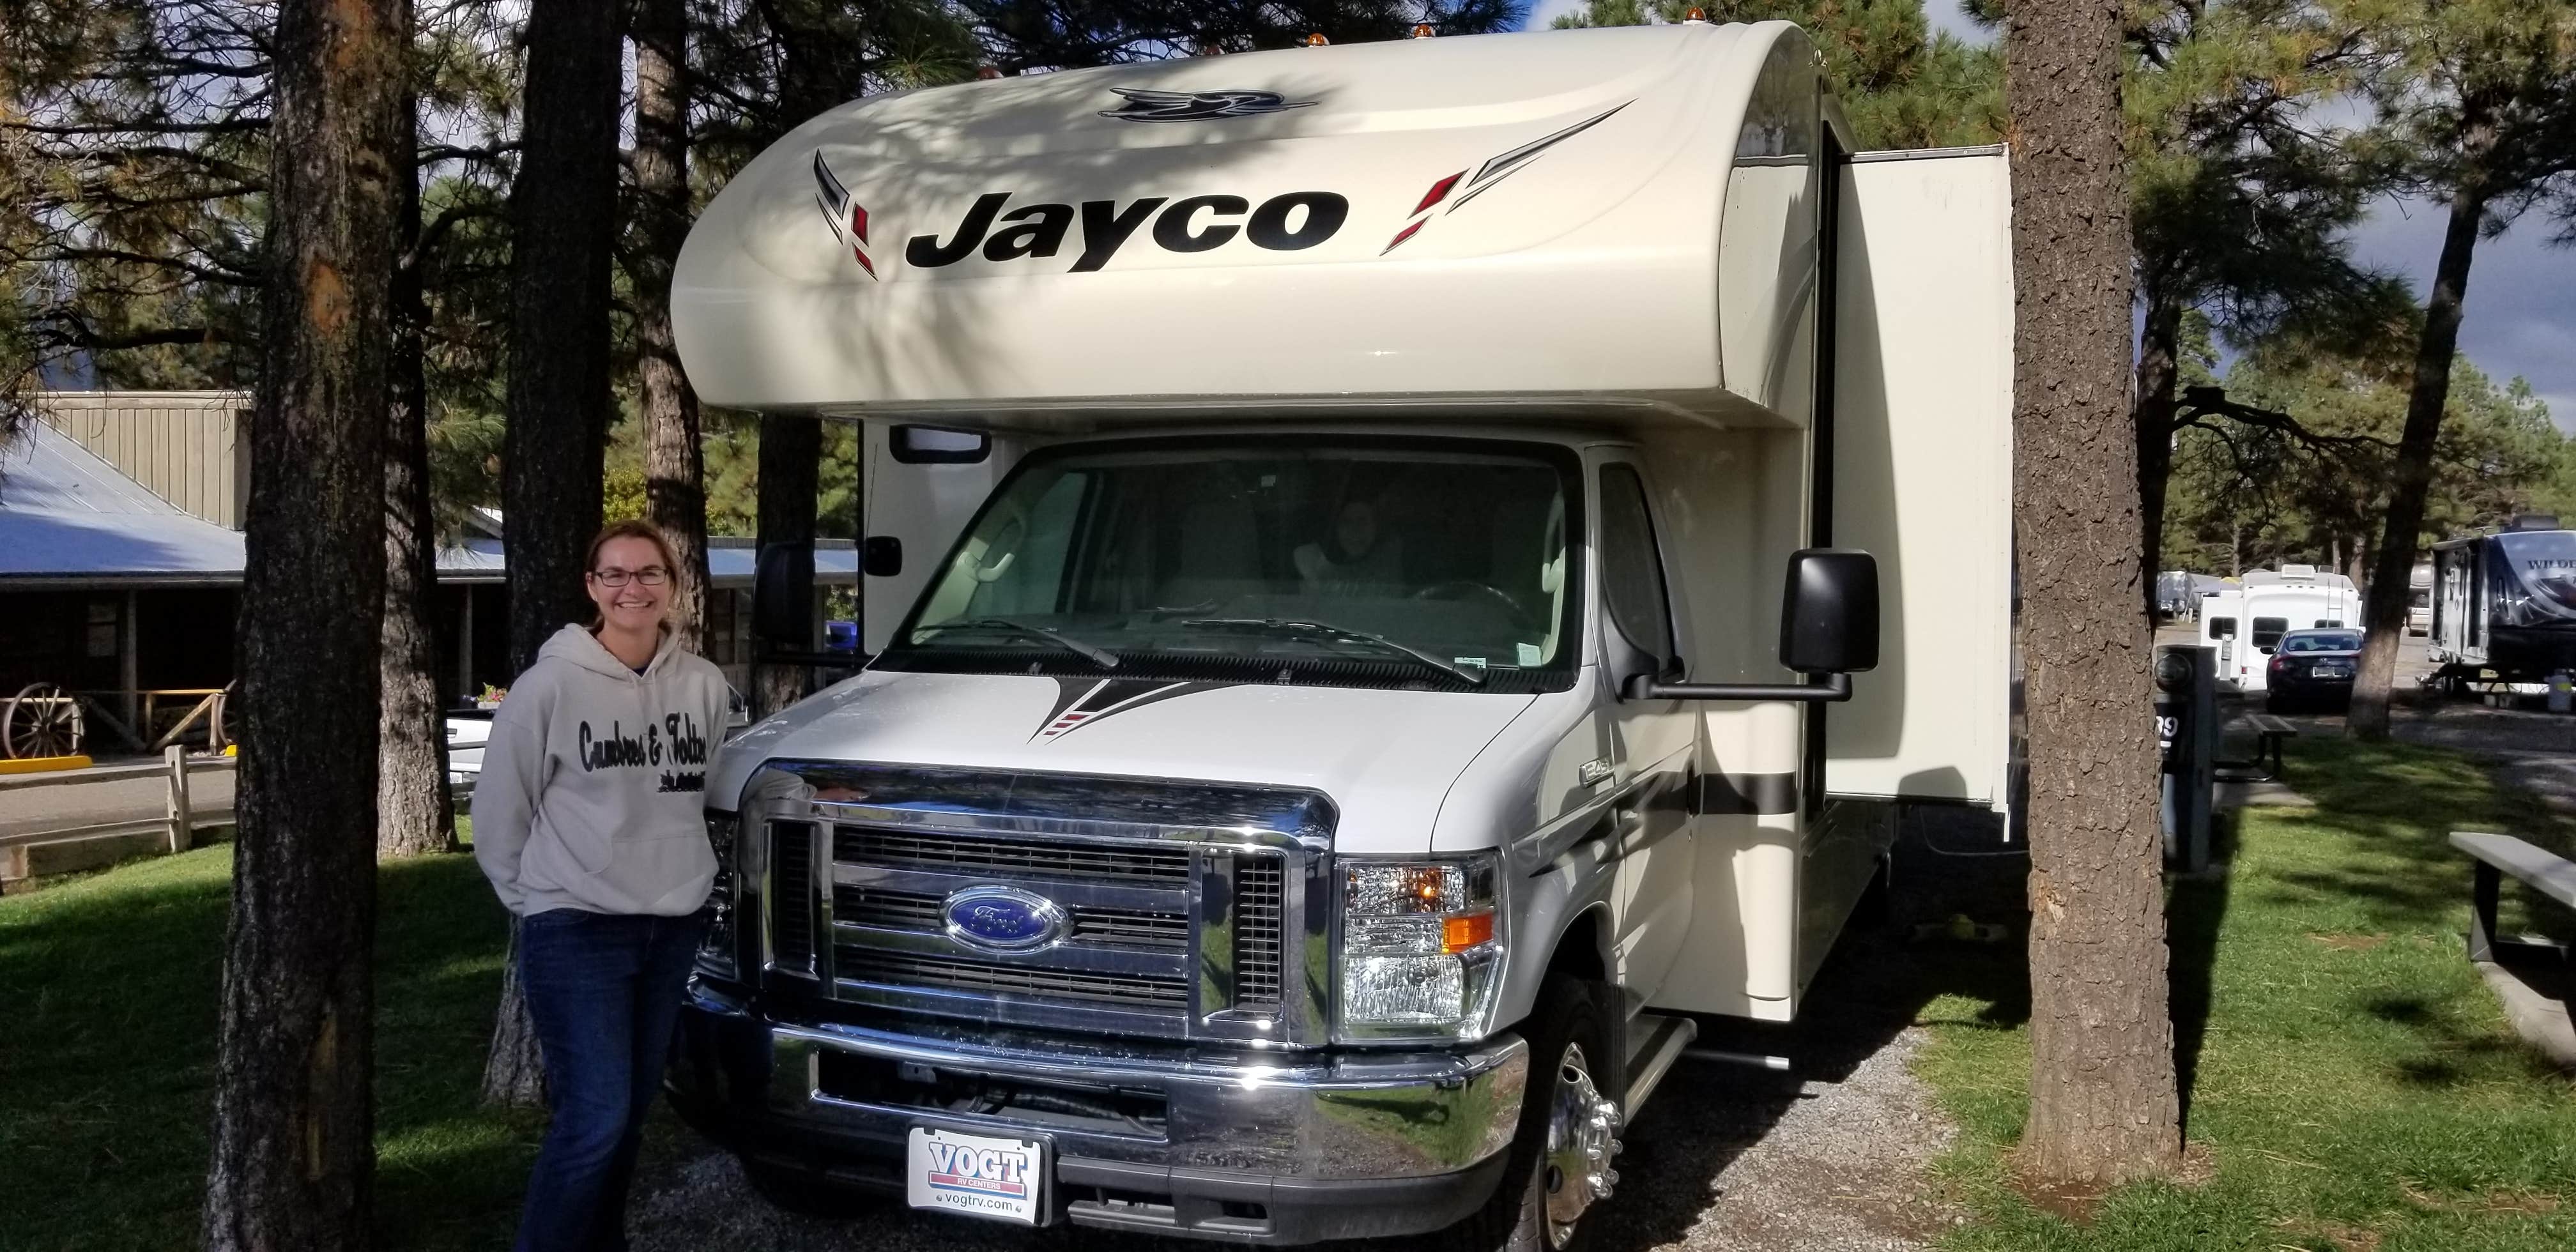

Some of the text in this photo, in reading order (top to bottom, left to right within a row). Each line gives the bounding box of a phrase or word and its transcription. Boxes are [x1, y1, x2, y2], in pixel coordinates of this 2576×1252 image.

[905, 191, 1349, 273] Jayco
[648, 723, 663, 767] &
[929, 1141, 1027, 1183] VOGT
[946, 1193, 1013, 1211] vogtrv.com
[968, 1180, 1000, 1189] CENTERS
